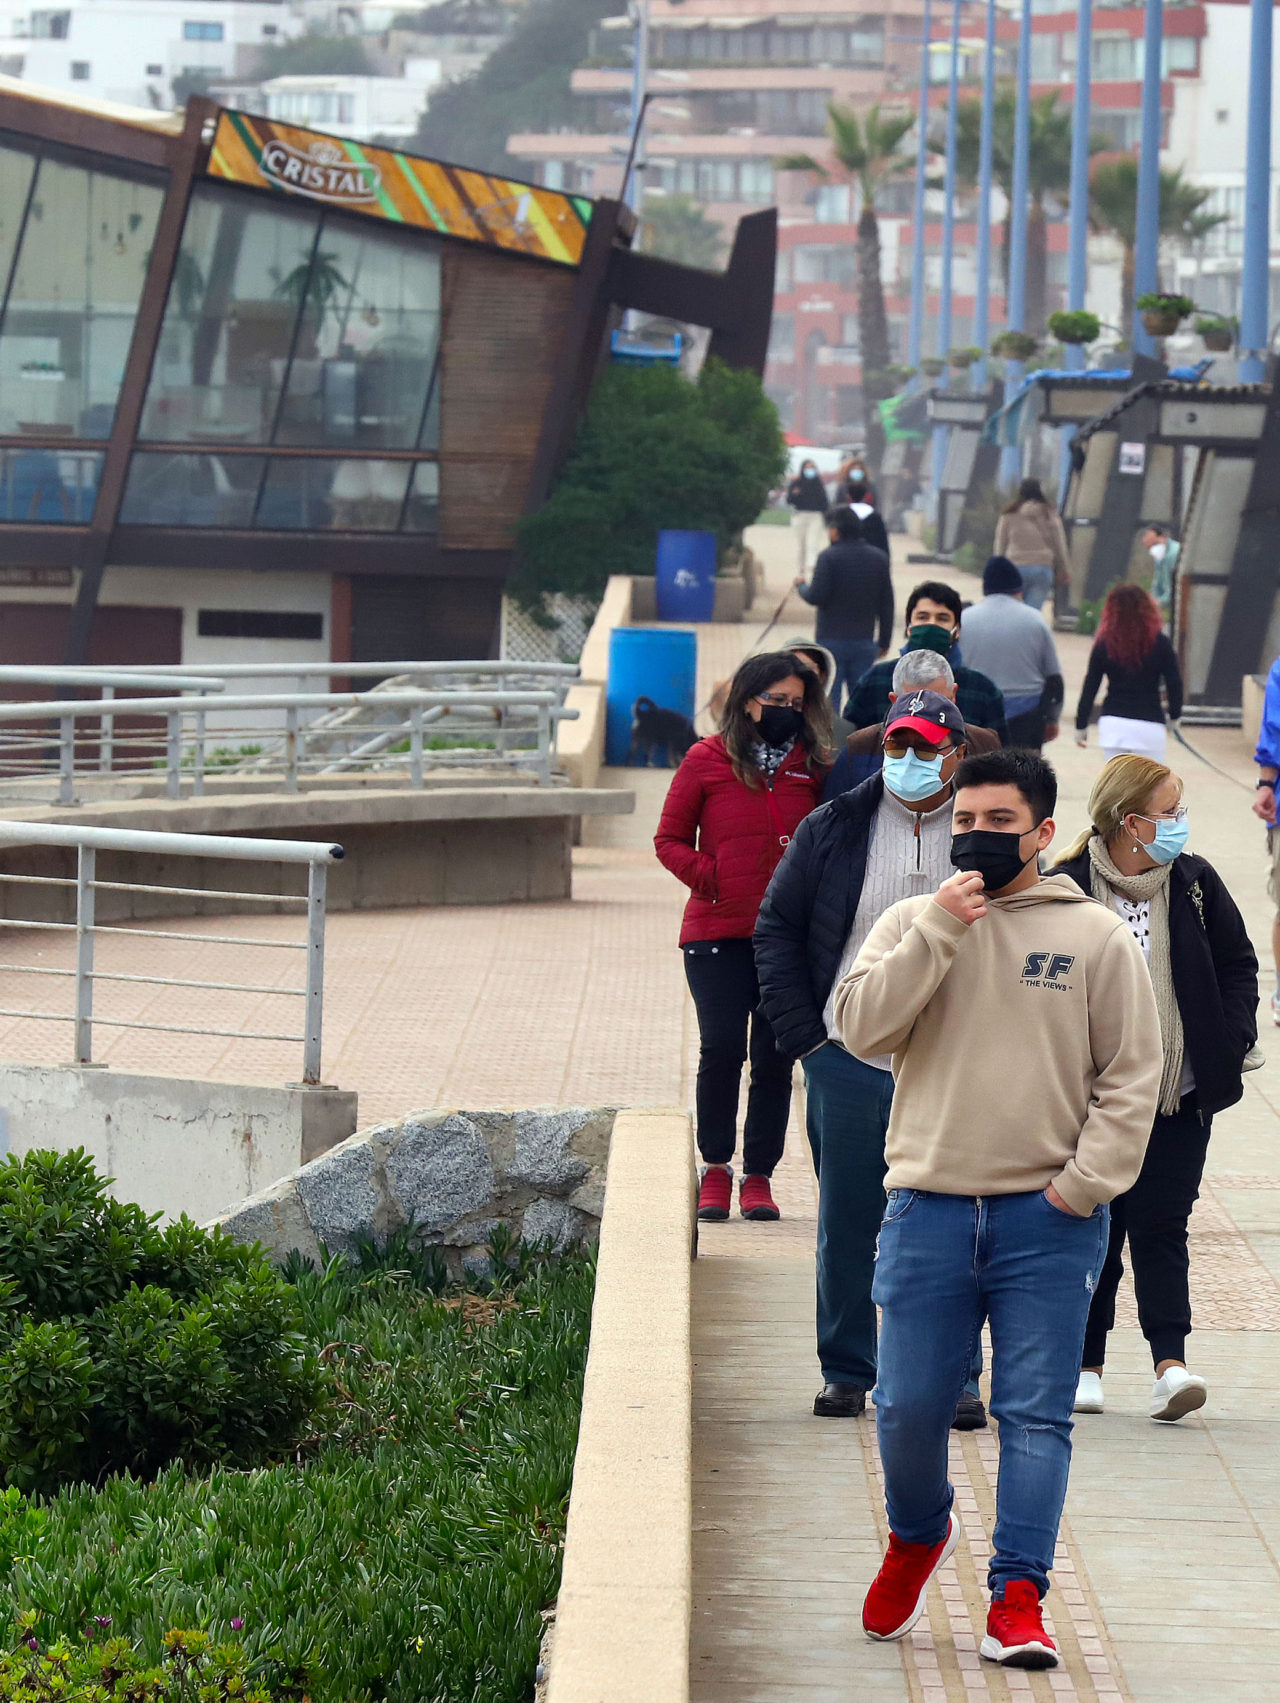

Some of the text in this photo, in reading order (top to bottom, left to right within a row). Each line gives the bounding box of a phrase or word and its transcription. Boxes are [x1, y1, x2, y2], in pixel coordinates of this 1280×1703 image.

[266, 149, 375, 194] CRISTAL
[939, 711, 946, 724] 3
[1021, 952, 1075, 980] SF
